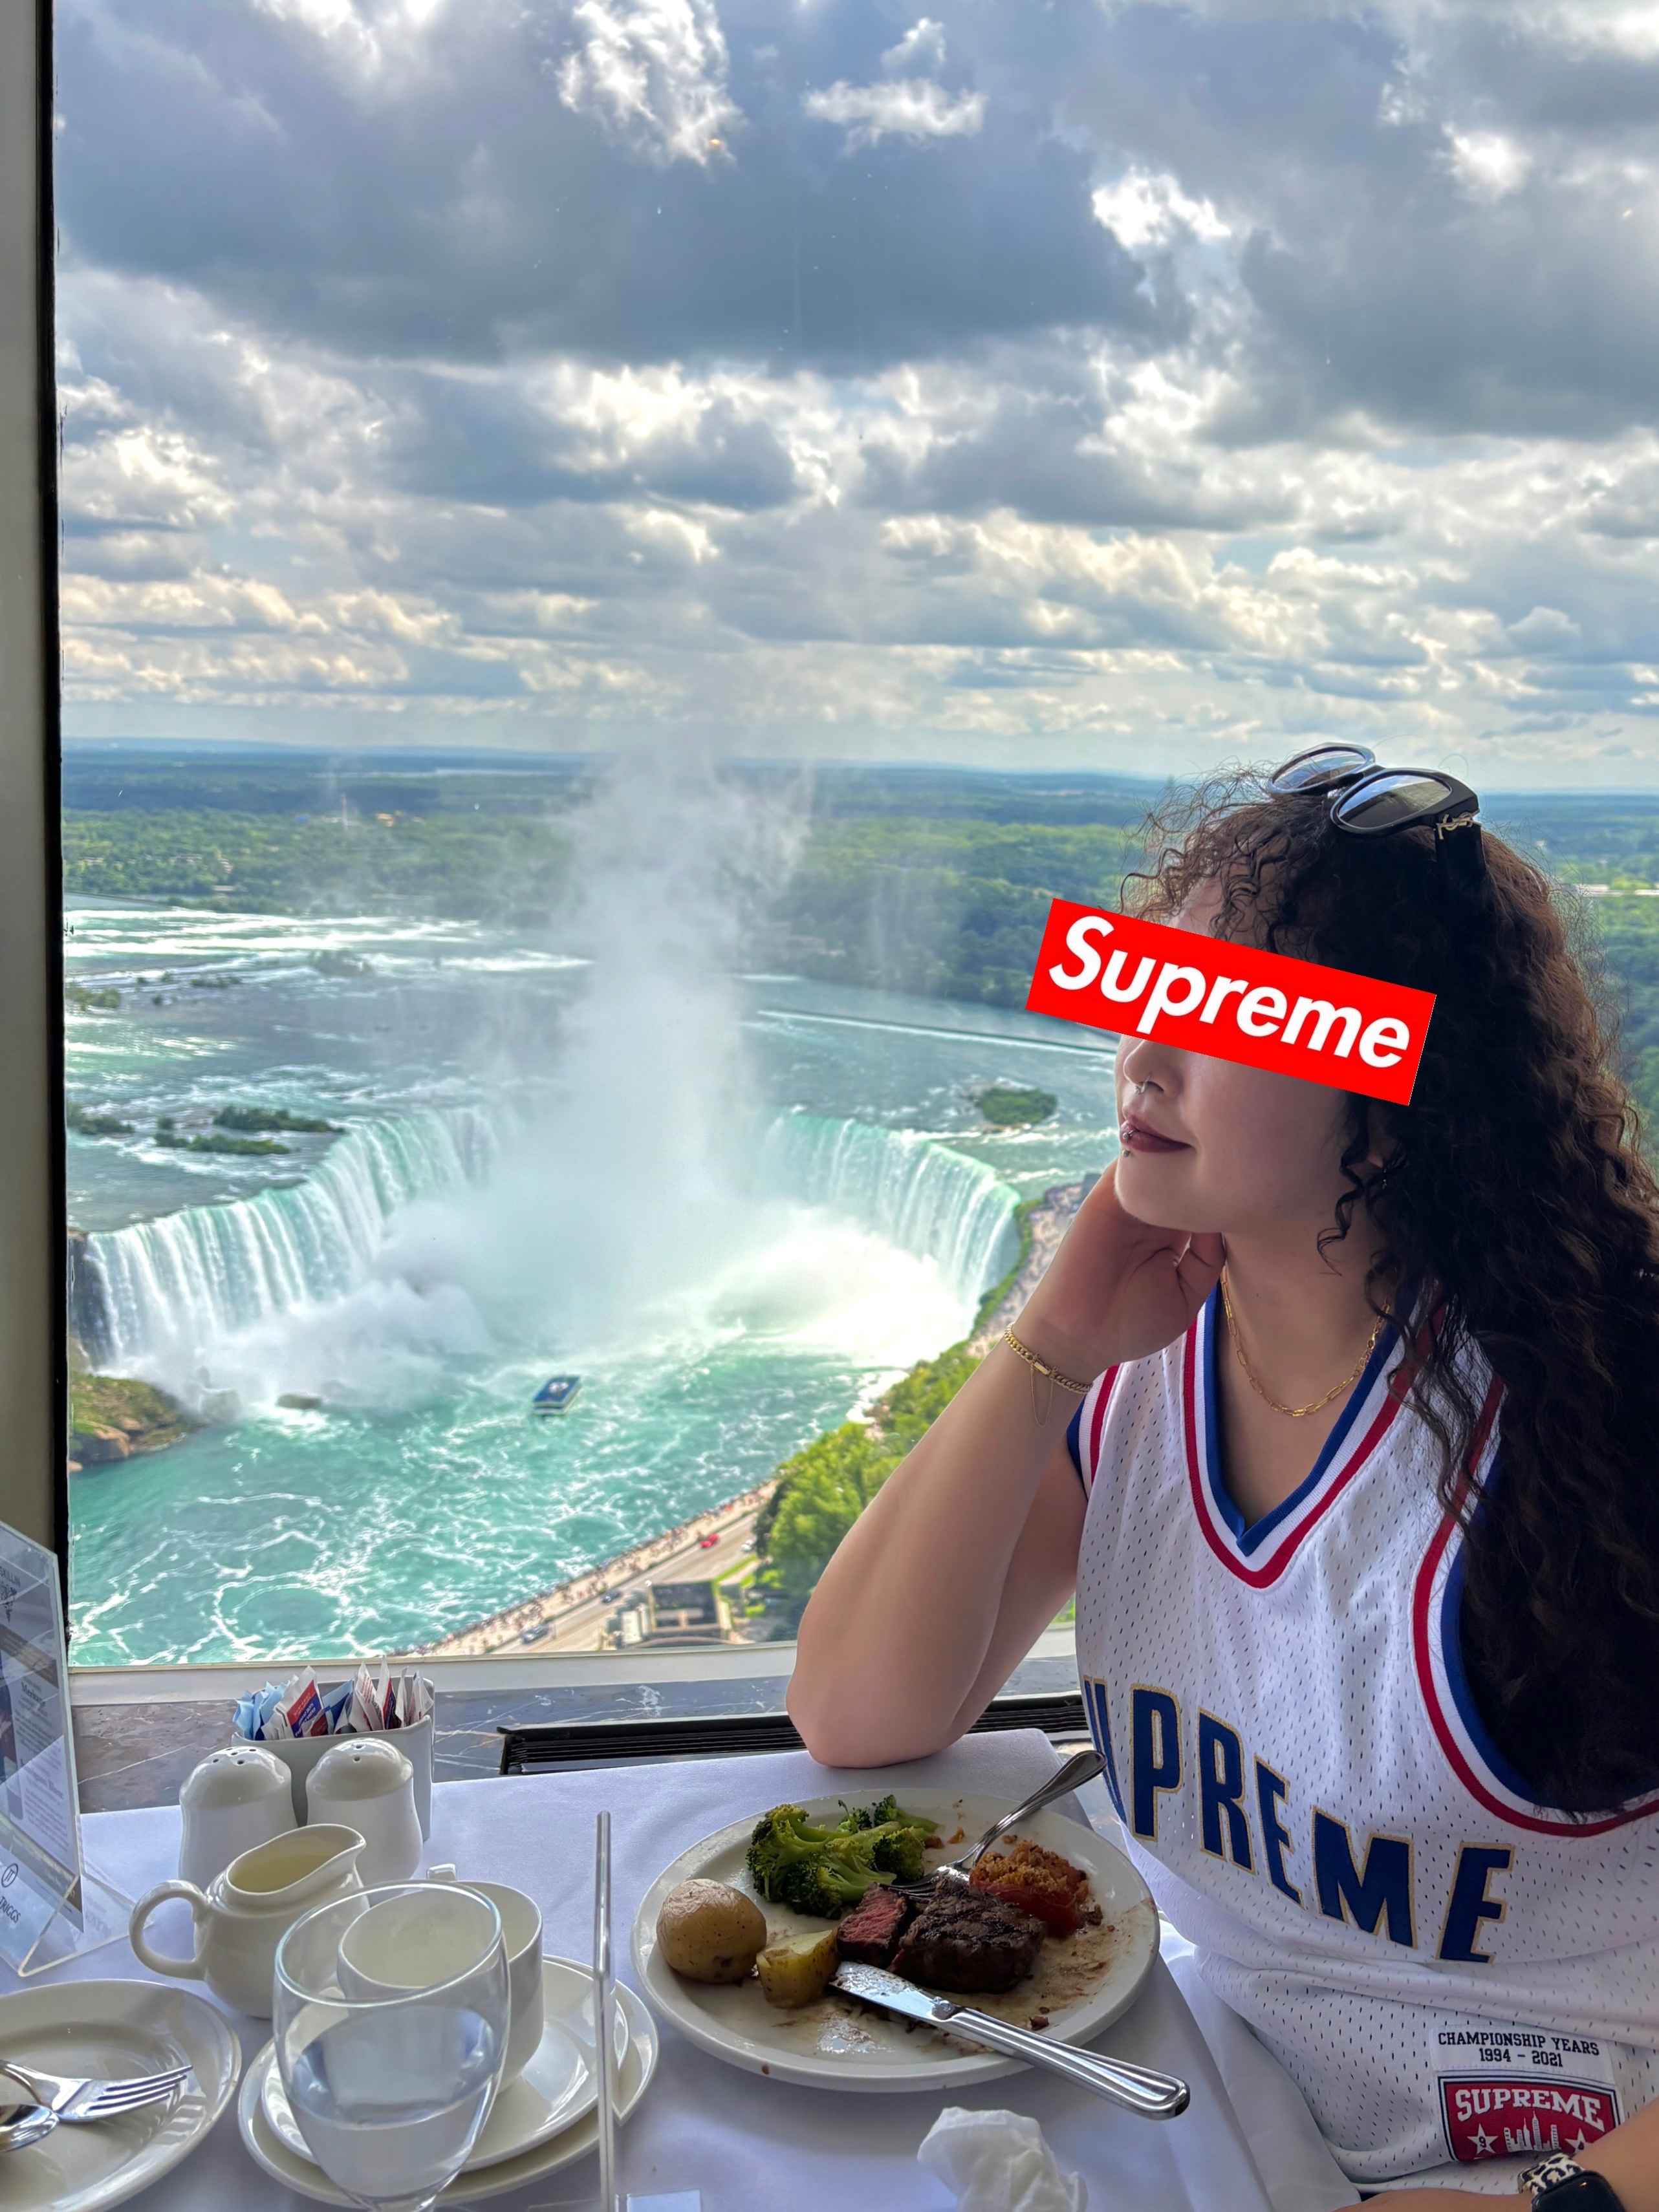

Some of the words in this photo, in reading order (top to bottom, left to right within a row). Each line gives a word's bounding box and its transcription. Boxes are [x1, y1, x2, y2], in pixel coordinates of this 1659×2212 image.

[1438, 2032, 1546, 2048] CHAMPIONSHIP
[1551, 2037, 1600, 2056] YEARS
[1479, 2048, 1512, 2063] 1994
[1532, 2050, 1564, 2068] 2021
[1455, 2089, 1606, 2133] SUPREME
